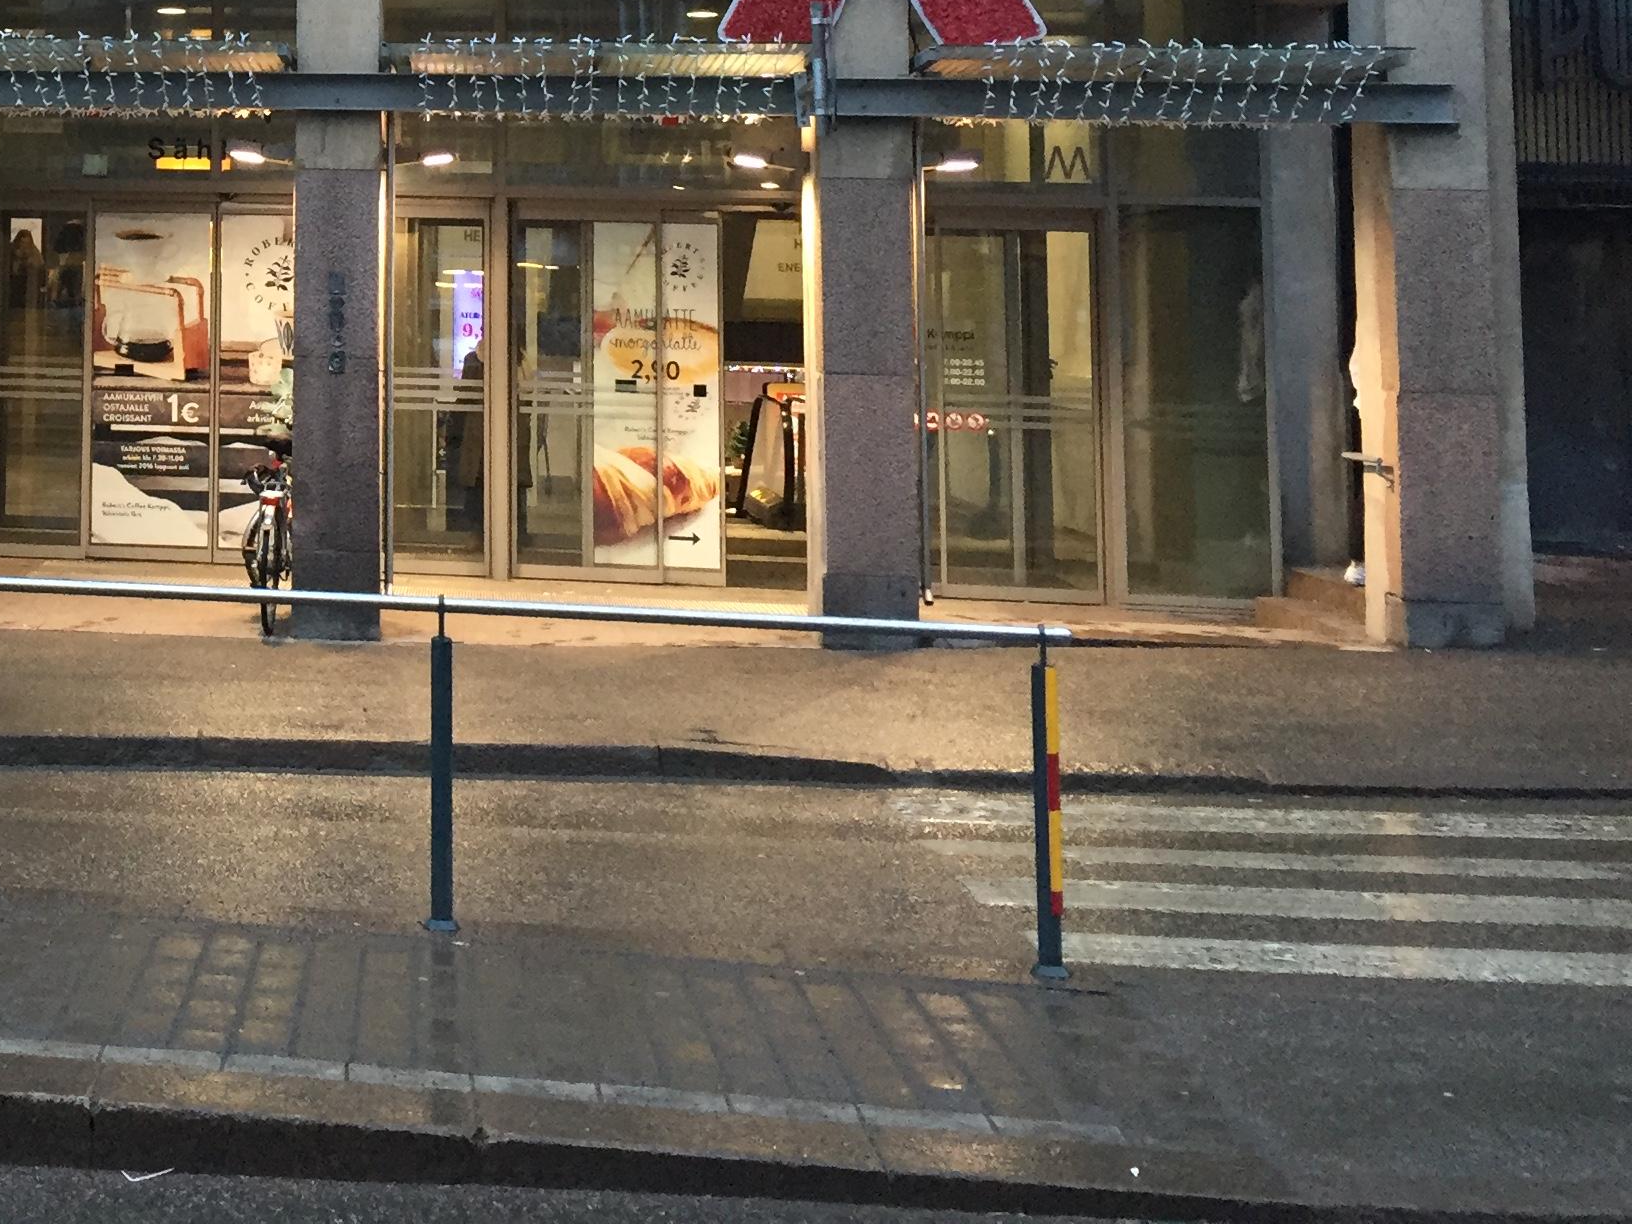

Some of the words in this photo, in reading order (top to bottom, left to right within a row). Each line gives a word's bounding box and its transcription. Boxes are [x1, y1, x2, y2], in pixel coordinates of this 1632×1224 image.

[102, 392, 164, 402] AAMUKAHVIN
[102, 403, 150, 413] OSTAJALLE
[166, 393, 200, 423] 1€
[102, 413, 152, 423] CROISSANT
